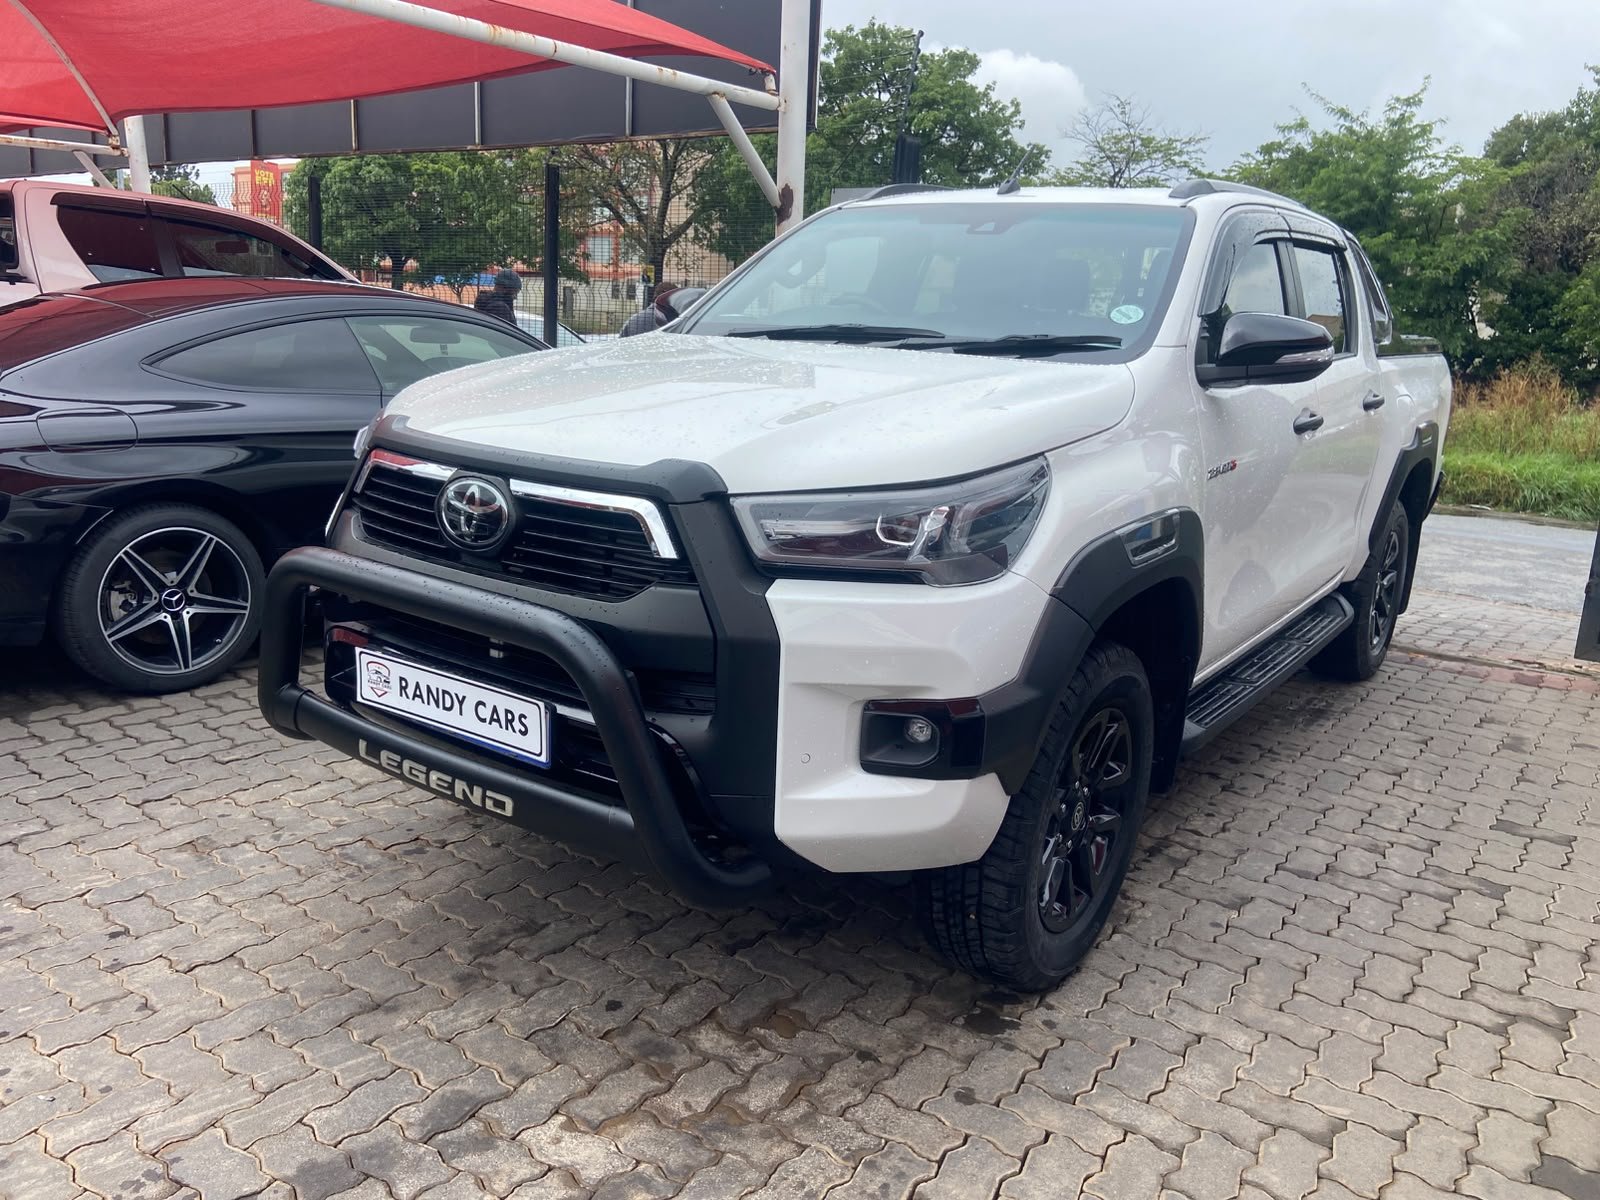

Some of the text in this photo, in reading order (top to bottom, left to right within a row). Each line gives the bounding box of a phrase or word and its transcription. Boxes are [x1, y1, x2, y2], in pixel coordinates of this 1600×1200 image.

[255, 169, 274, 179] VOTE
[399, 675, 529, 737] RANDY CARS
[358, 738, 514, 817] LEGEND
